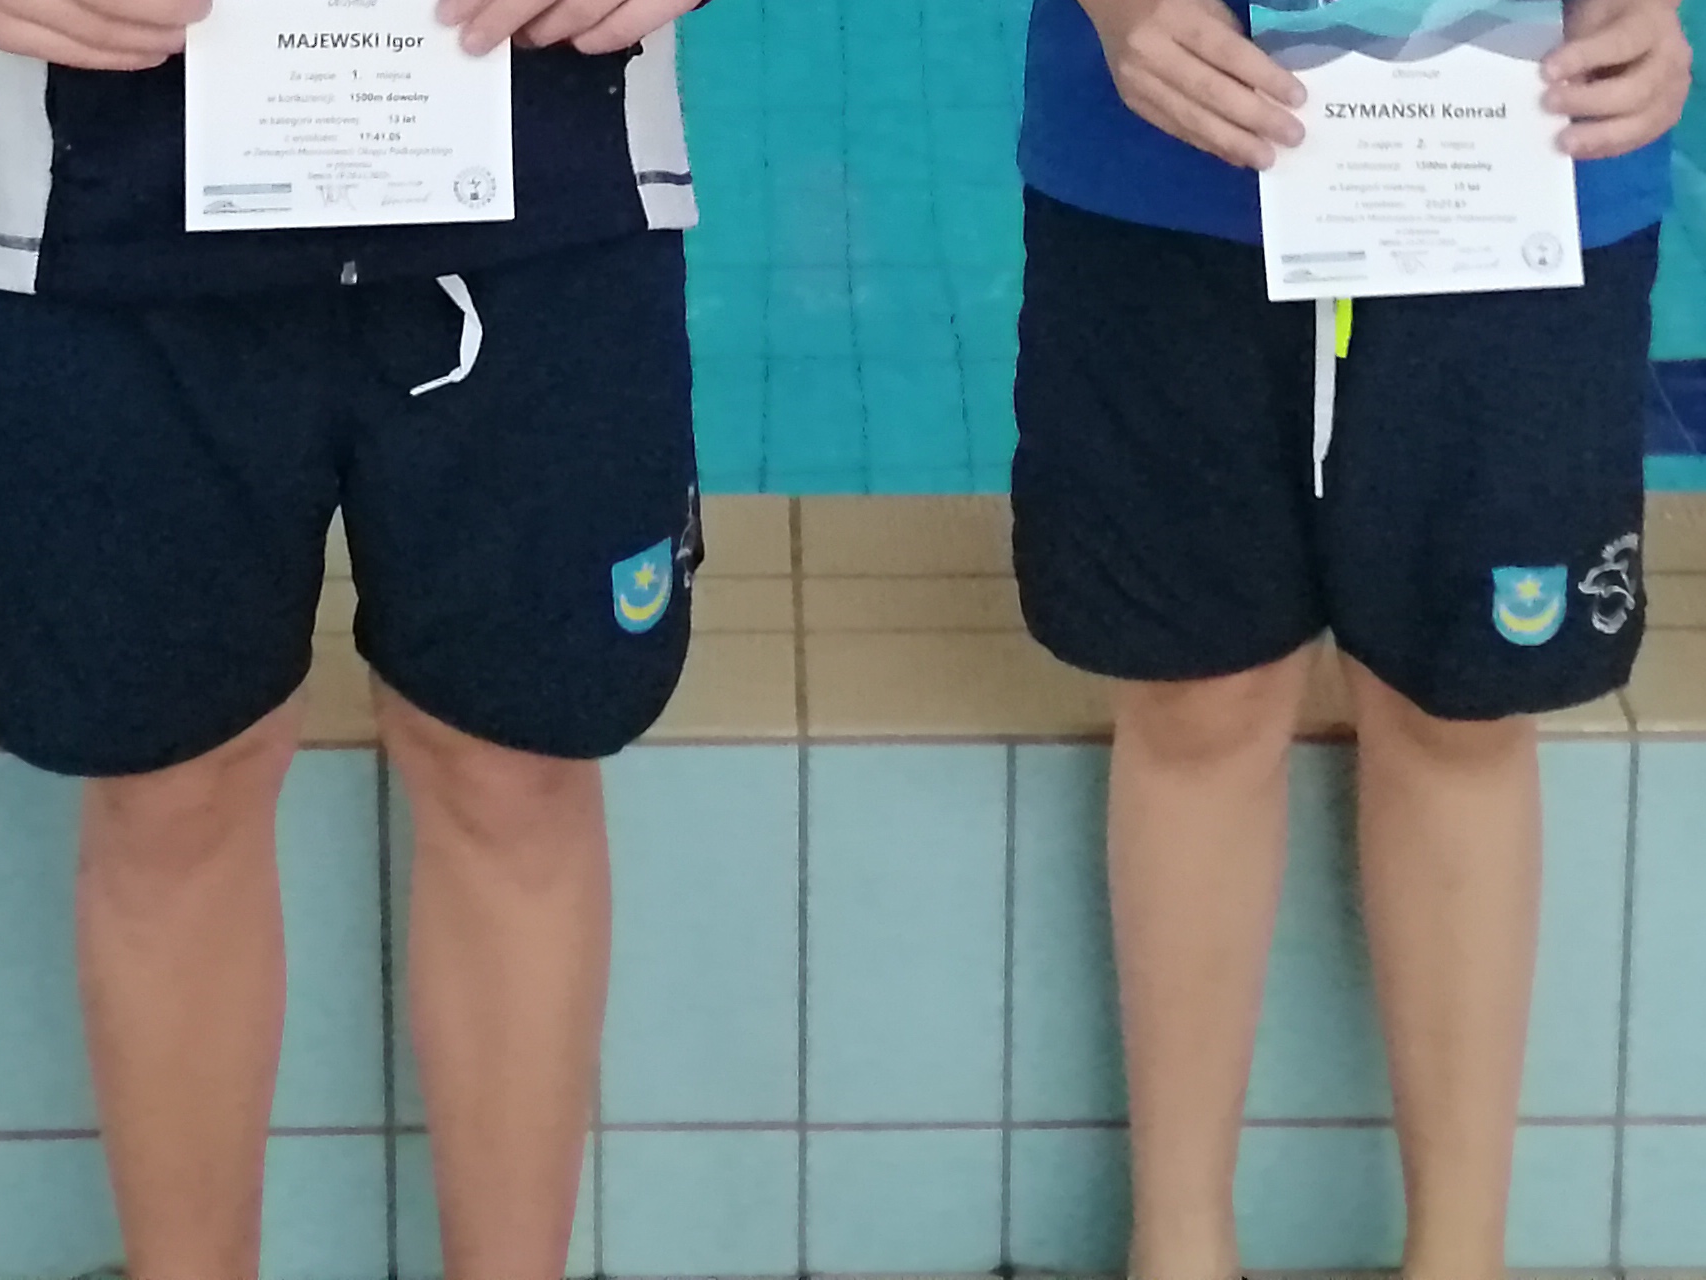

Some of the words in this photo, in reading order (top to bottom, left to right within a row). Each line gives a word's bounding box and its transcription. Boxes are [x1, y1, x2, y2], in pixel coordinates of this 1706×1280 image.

[277, 32, 379, 50] MAJEWSKI
[386, 33, 425, 52] Igor
[1442, 102, 1507, 119] Konrad
